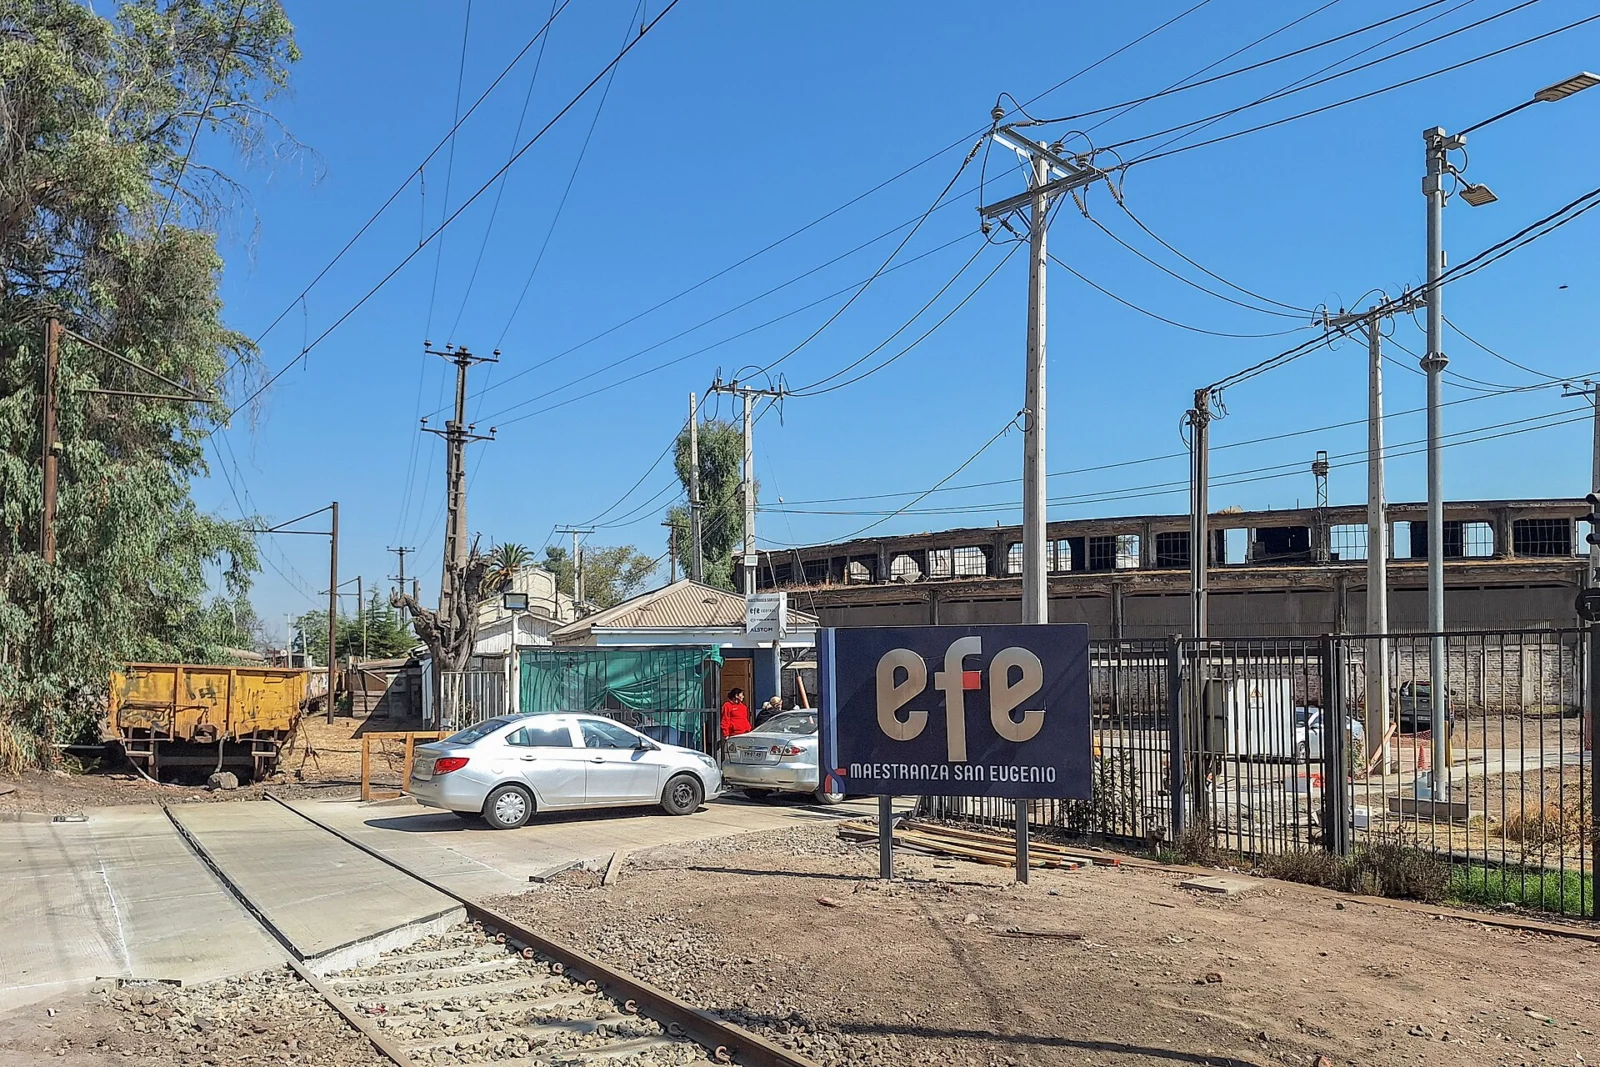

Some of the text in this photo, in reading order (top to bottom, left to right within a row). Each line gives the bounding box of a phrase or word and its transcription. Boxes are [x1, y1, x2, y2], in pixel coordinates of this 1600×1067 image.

[875, 635, 1046, 762] efe
[850, 763, 1056, 783] MAESTRANZA SAN EUGENIO
